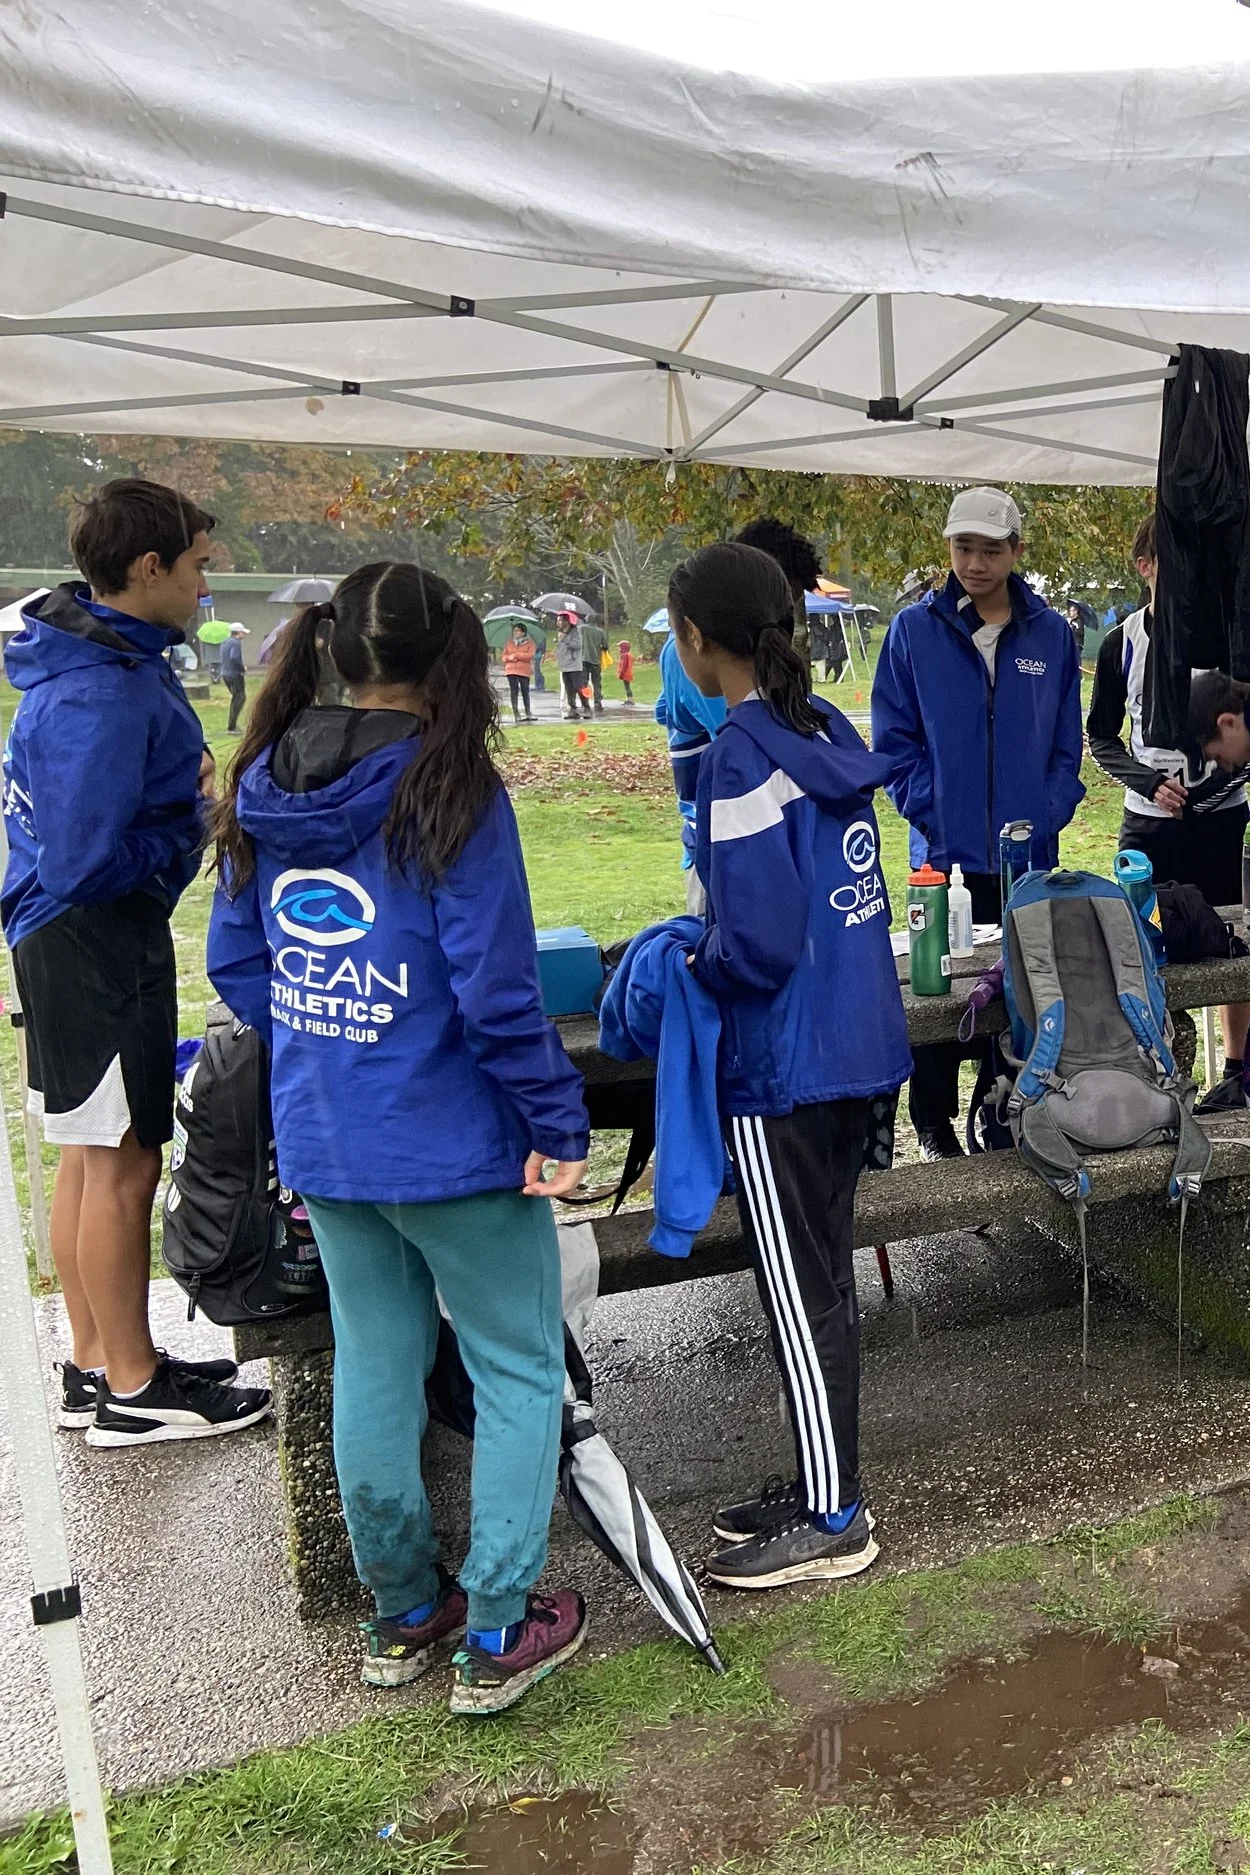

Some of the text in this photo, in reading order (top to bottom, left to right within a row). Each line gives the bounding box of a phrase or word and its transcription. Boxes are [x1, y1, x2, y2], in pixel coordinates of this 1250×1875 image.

[1014, 658, 1047, 669] OCEAN
[829, 873, 882, 911] OCEA
[844, 897, 885, 928] ATHLETI
[267, 940, 408, 998] CEAN
[270, 979, 394, 1024] THLETICS
[270, 1003, 379, 1043] RACK & FIELD CLUB
